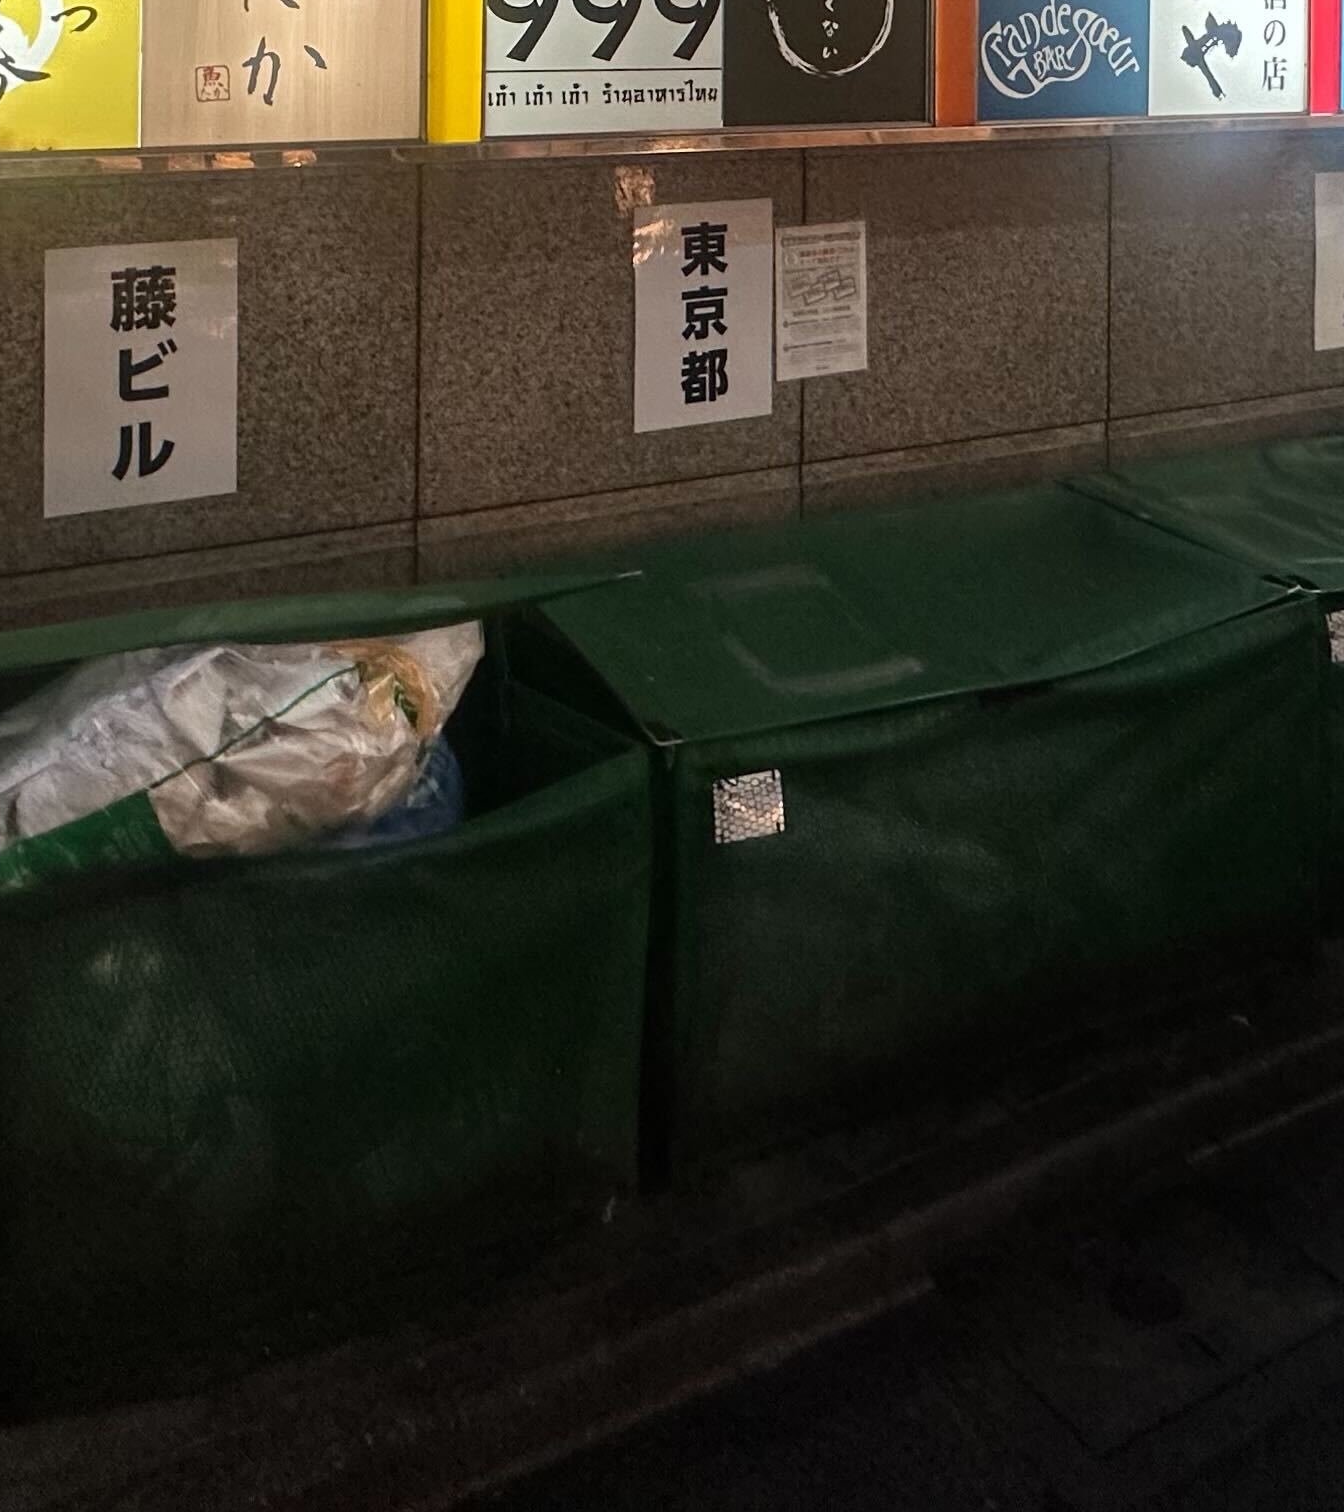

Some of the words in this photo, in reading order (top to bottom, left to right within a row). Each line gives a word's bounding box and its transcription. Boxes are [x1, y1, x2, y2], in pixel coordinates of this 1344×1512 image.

[1033, 44, 1076, 81] BAR
[110, 266, 177, 483] 藤ビル
[680, 222, 729, 406] 東京都
